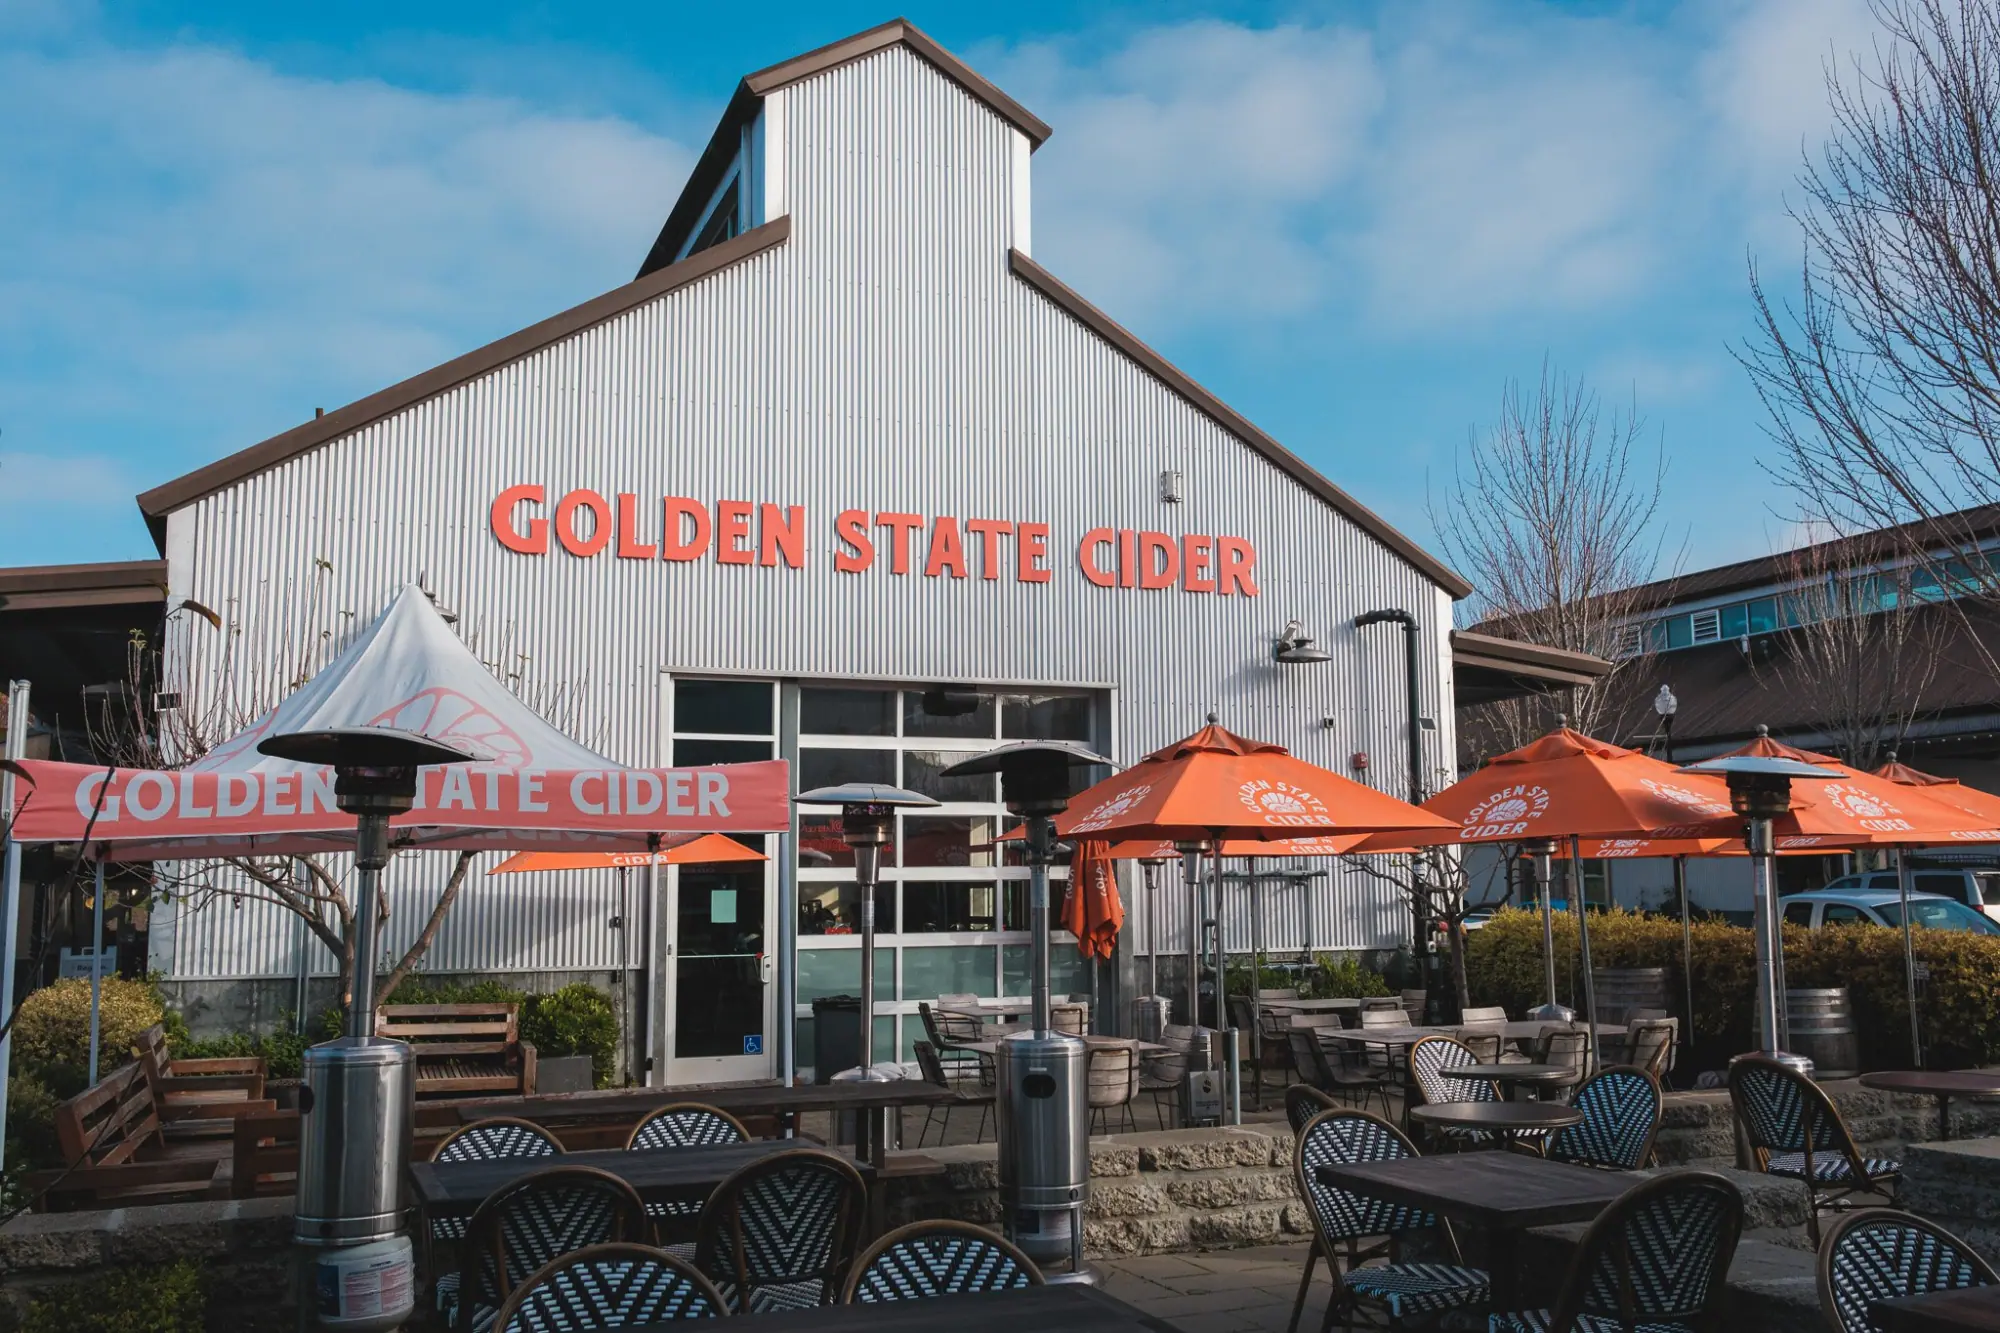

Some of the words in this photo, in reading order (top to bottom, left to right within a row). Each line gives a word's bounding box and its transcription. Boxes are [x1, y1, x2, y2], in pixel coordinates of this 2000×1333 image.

[491, 484, 805, 569] GOLDEN
[834, 509, 1051, 583] STATE
[1079, 527, 1259, 597] CIDER
[75, 769, 338, 821] GOLDEN
[413, 765, 549, 813] TATE
[569, 771, 732, 818] CIDER
[1239, 780, 1271, 813] GOLDEN
[1277, 781, 1328, 813] STATE
[1846, 785, 1903, 815] STATE
[1464, 785, 1526, 825] GOLDEN
[1526, 785, 1550, 819] STATE
[1264, 815, 1336, 826] CIDER
[1460, 822, 1528, 839] CIDER
[1860, 818, 1916, 832] CIDER
[1290, 846, 1337, 854] CIDER
[1596, 848, 1639, 857] CIDER
